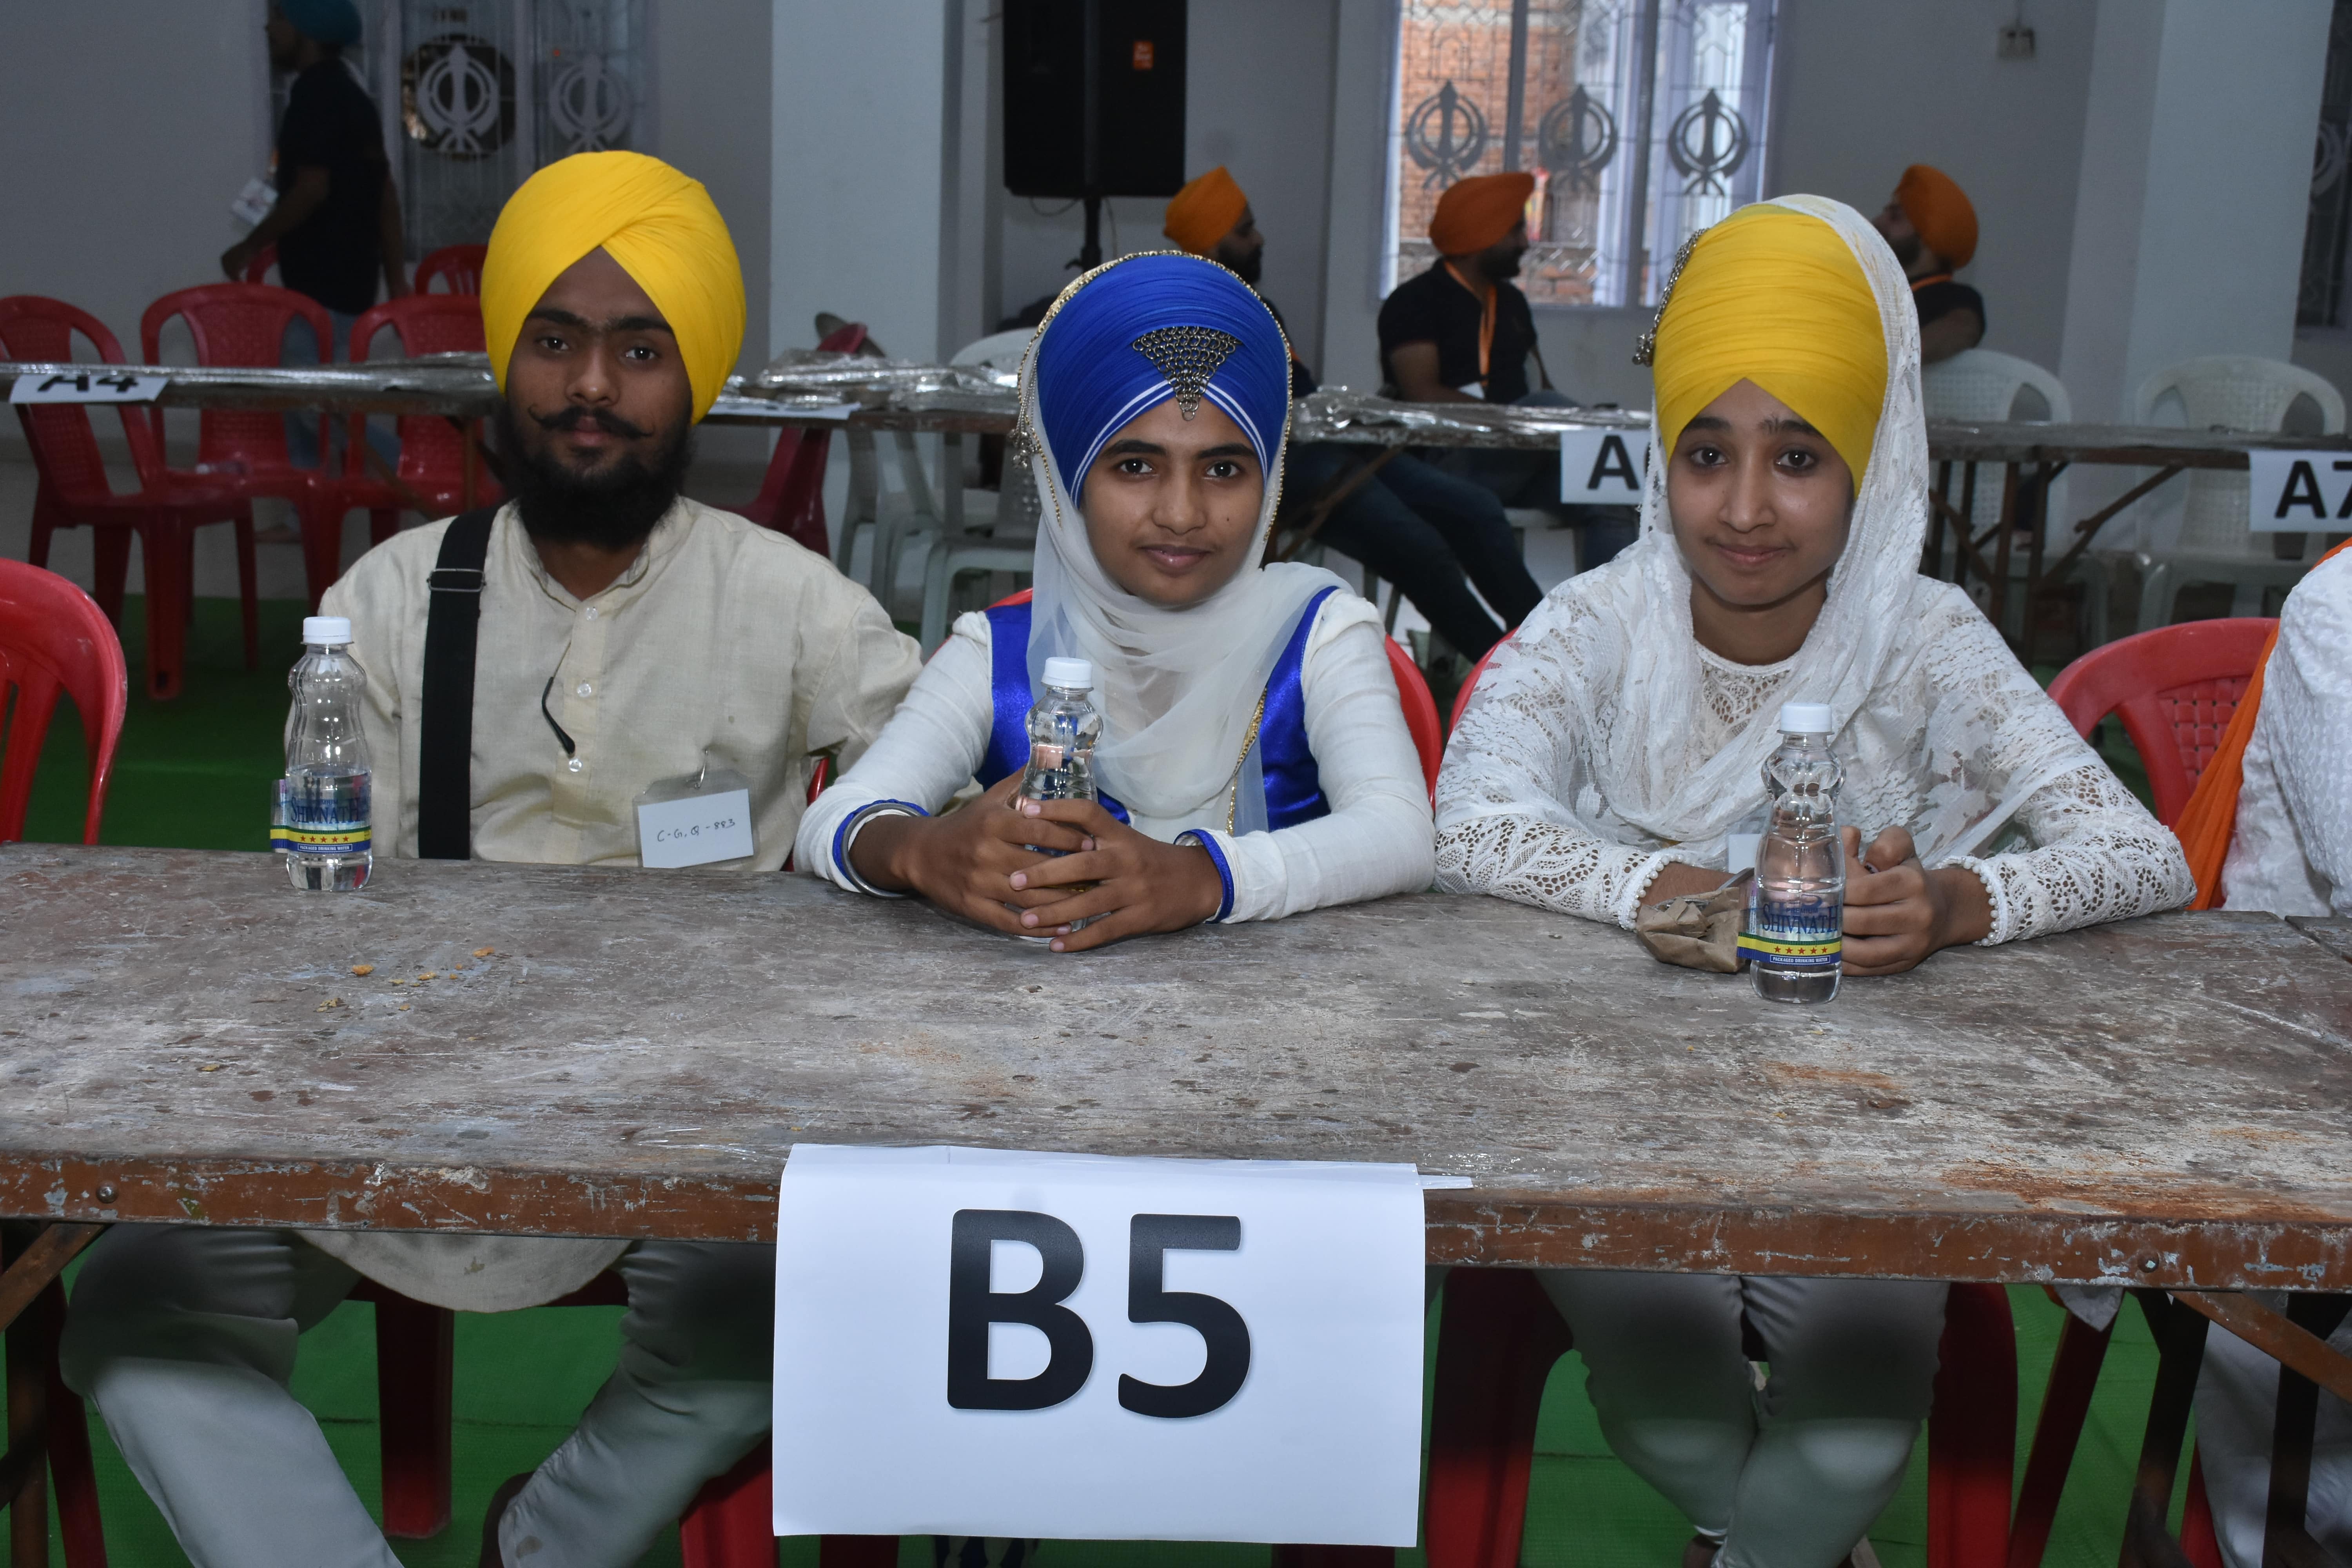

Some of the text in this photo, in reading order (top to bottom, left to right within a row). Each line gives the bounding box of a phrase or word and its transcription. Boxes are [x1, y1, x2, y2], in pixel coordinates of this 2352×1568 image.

[38, 375, 139, 392] A4
[1587, 434, 1651, 490] A
[291, 796, 361, 824] SHIVNATH
[1762, 904, 1838, 934] SHIVNATH
[947, 1209, 1252, 1419] B5
